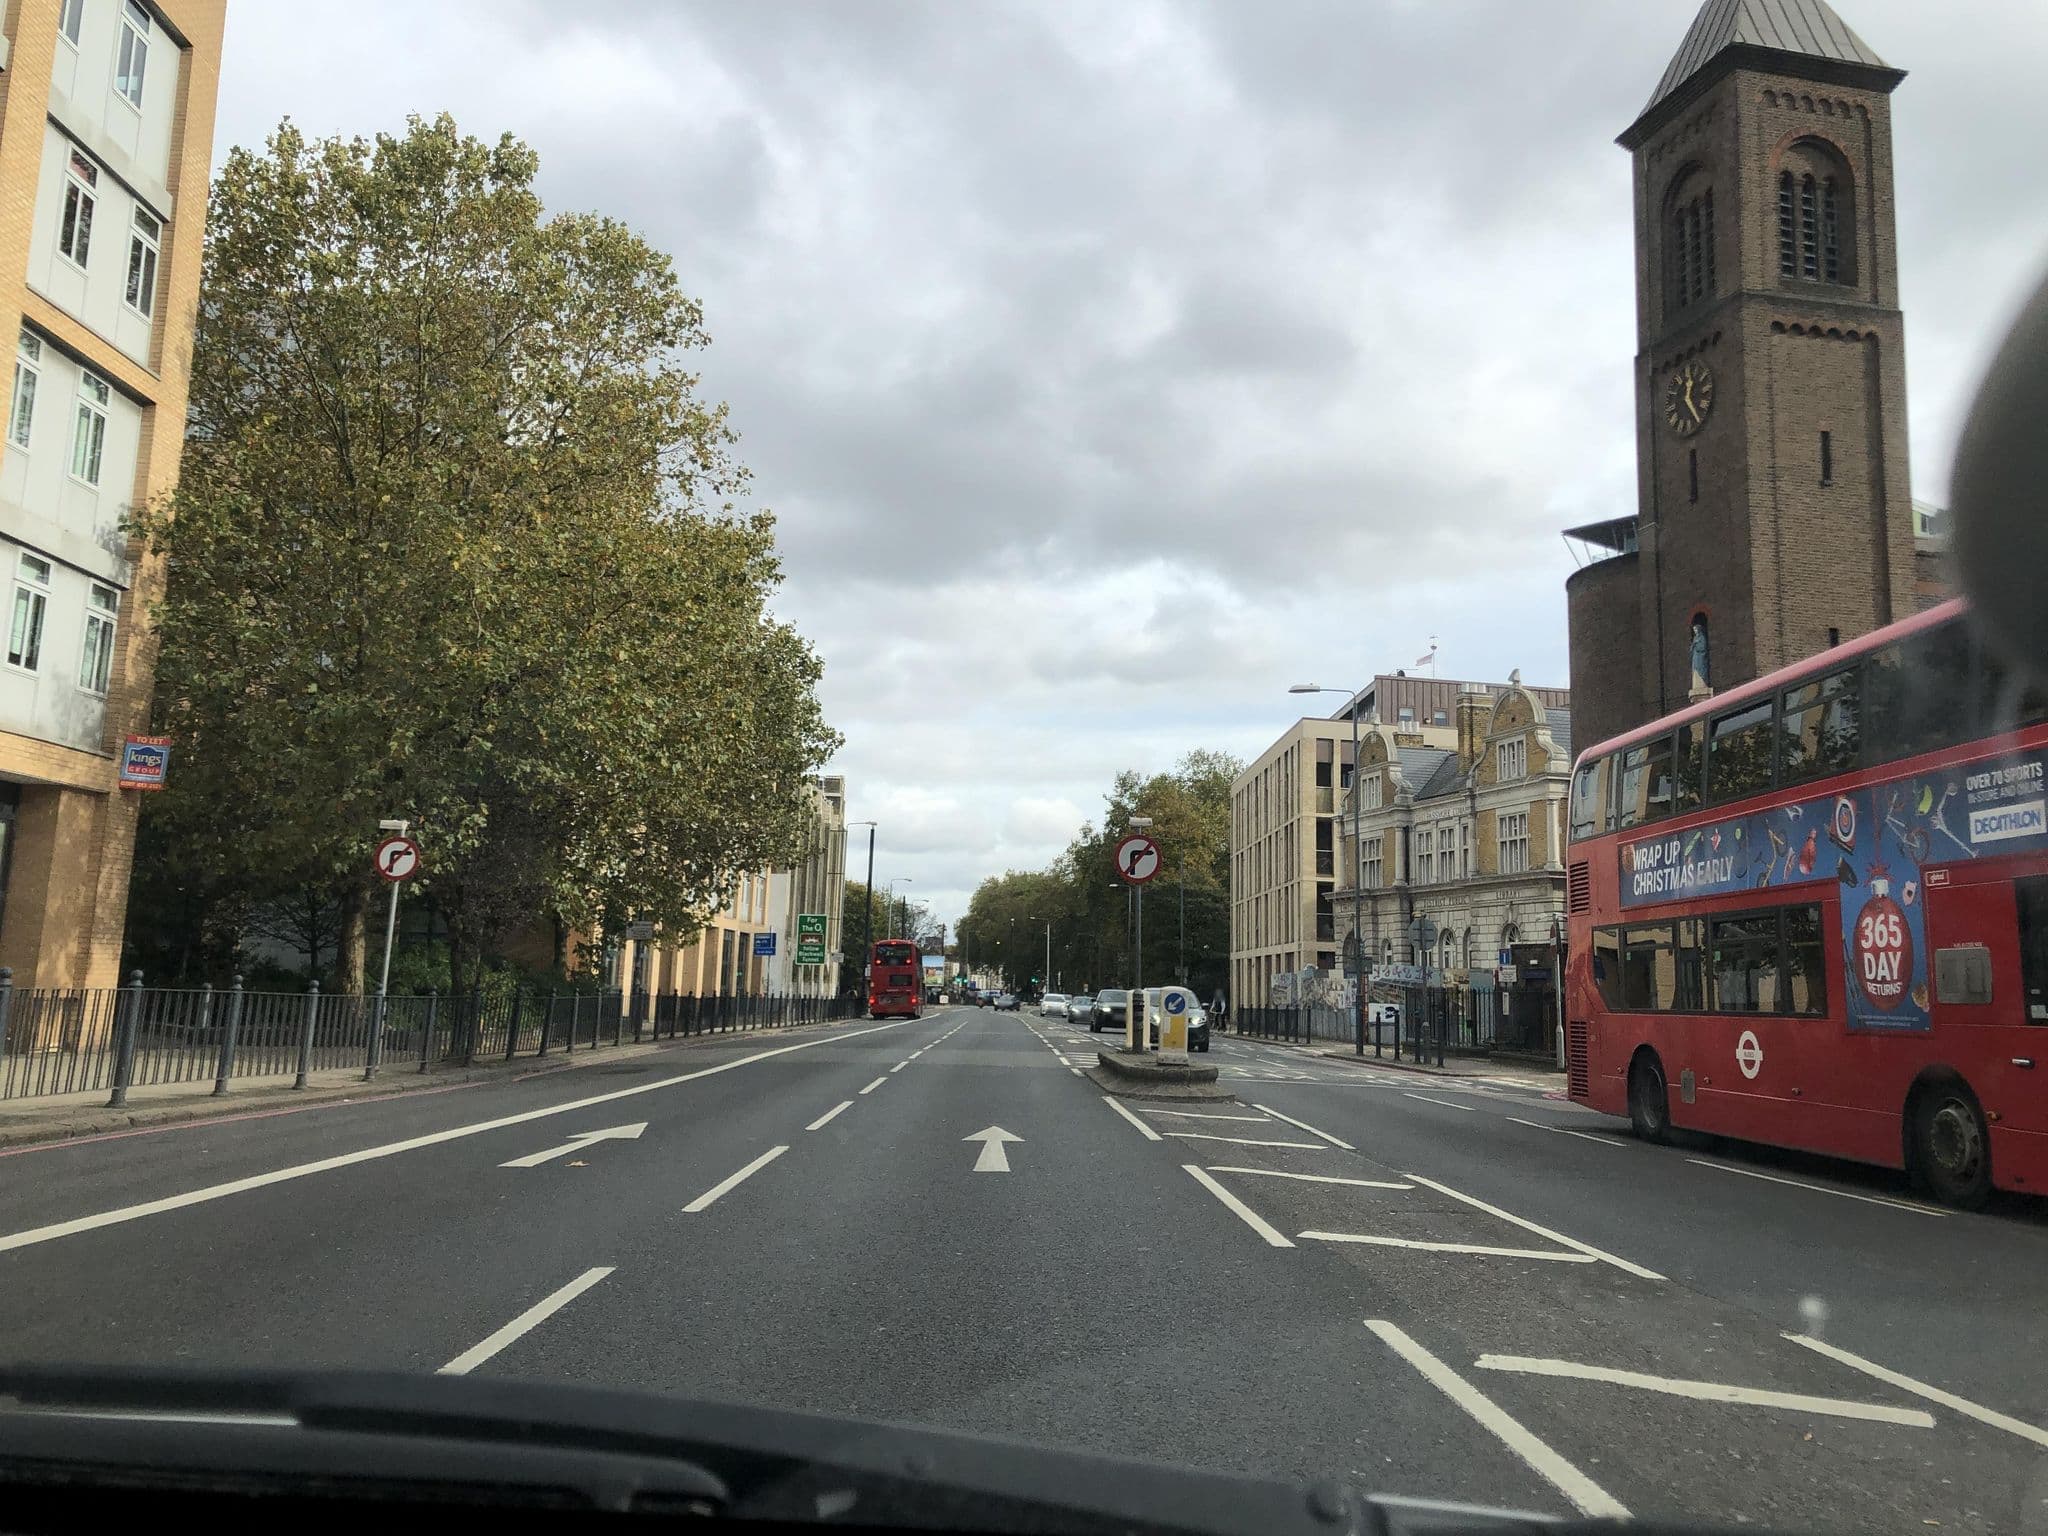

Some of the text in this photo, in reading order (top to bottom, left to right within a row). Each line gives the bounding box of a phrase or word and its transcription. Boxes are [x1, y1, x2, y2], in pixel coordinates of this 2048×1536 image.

[149, 737, 164, 745] LET
[128, 766, 160, 775] GROUP
[130, 750, 162, 767] kings
[1966, 773, 1991, 791] OVER
[2003, 762, 2043, 783] SPORTS
[1975, 809, 2041, 835] DECATHLON
[1630, 840, 1681, 872] WRAP UP
[1633, 856, 1734, 896] CHRISTMAS EARLY
[807, 916, 818, 924] For
[1860, 913, 1902, 949] 365
[1863, 951, 1902, 981] DAY
